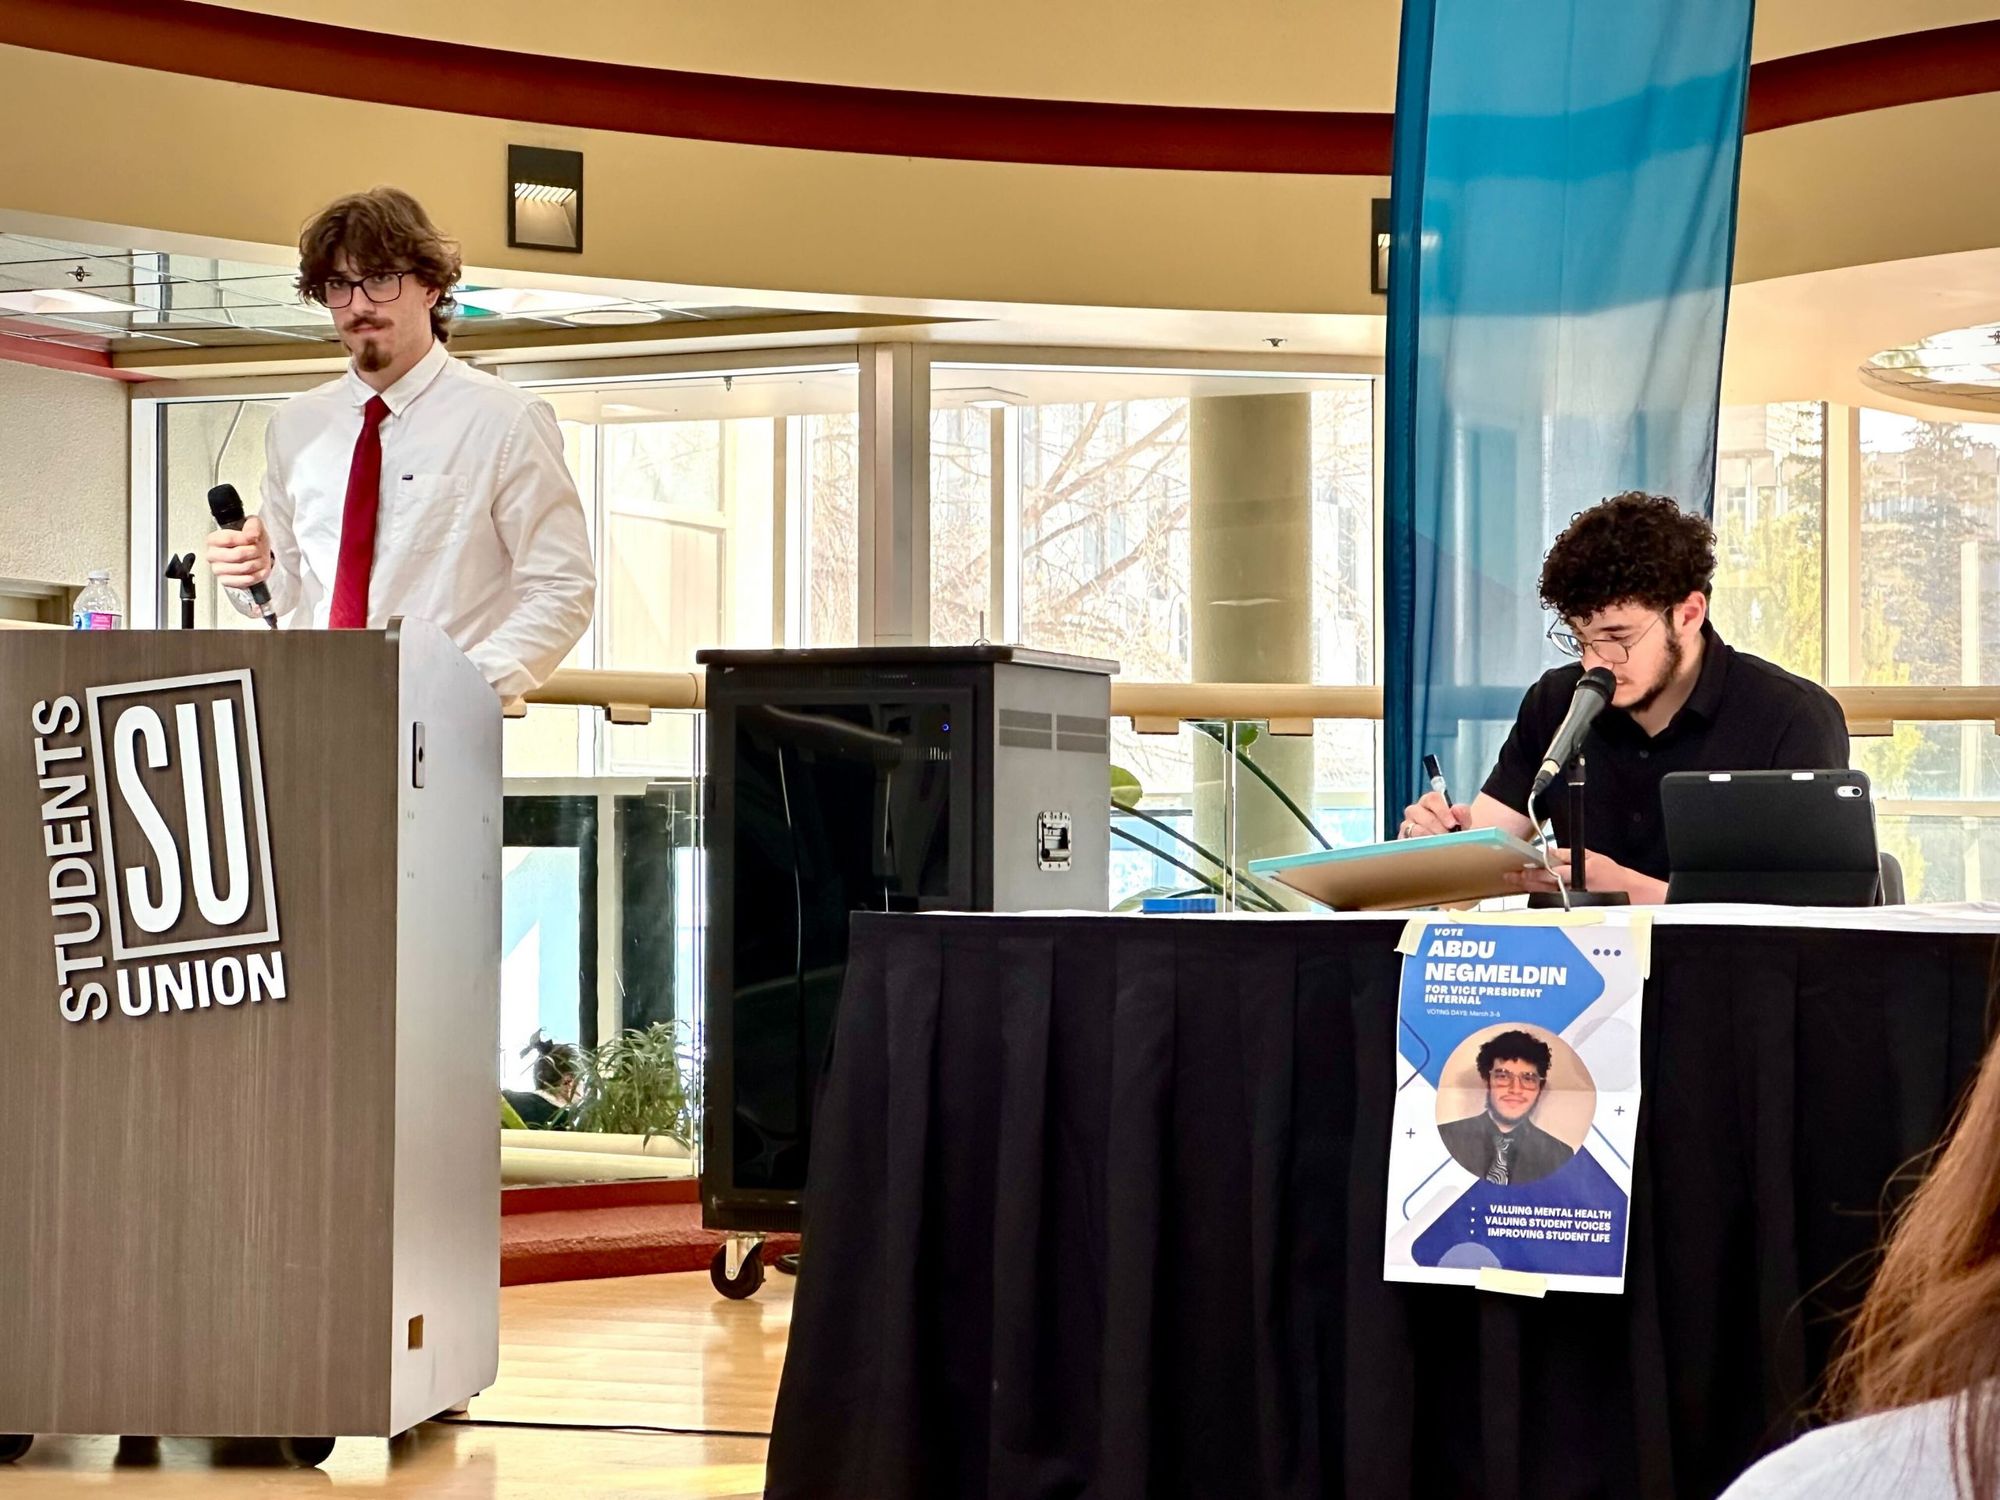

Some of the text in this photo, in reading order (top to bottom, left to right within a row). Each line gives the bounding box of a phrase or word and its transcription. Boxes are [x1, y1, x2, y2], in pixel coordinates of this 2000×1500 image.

[114, 699, 250, 933] SU
[32, 696, 107, 1022] STUDENTS
[1434, 928, 1464, 937] VOTE
[1427, 940, 1496, 959] ABDU
[1424, 963, 1568, 986] NEGMELDIN
[117, 951, 286, 1017] UNION
[1425, 985, 1542, 998] FOR VICE PRESIDENT
[1424, 994, 1481, 1005] INTERNAL
[1426, 1008, 1450, 1016] VOTING
[1490, 1204, 1611, 1219] VALUING MENTAL HEALTH
[1485, 1216, 1611, 1231] VALUING STUDENT VOICES
[1487, 1228, 1610, 1243] IMPROVING STUDENT LIFE
